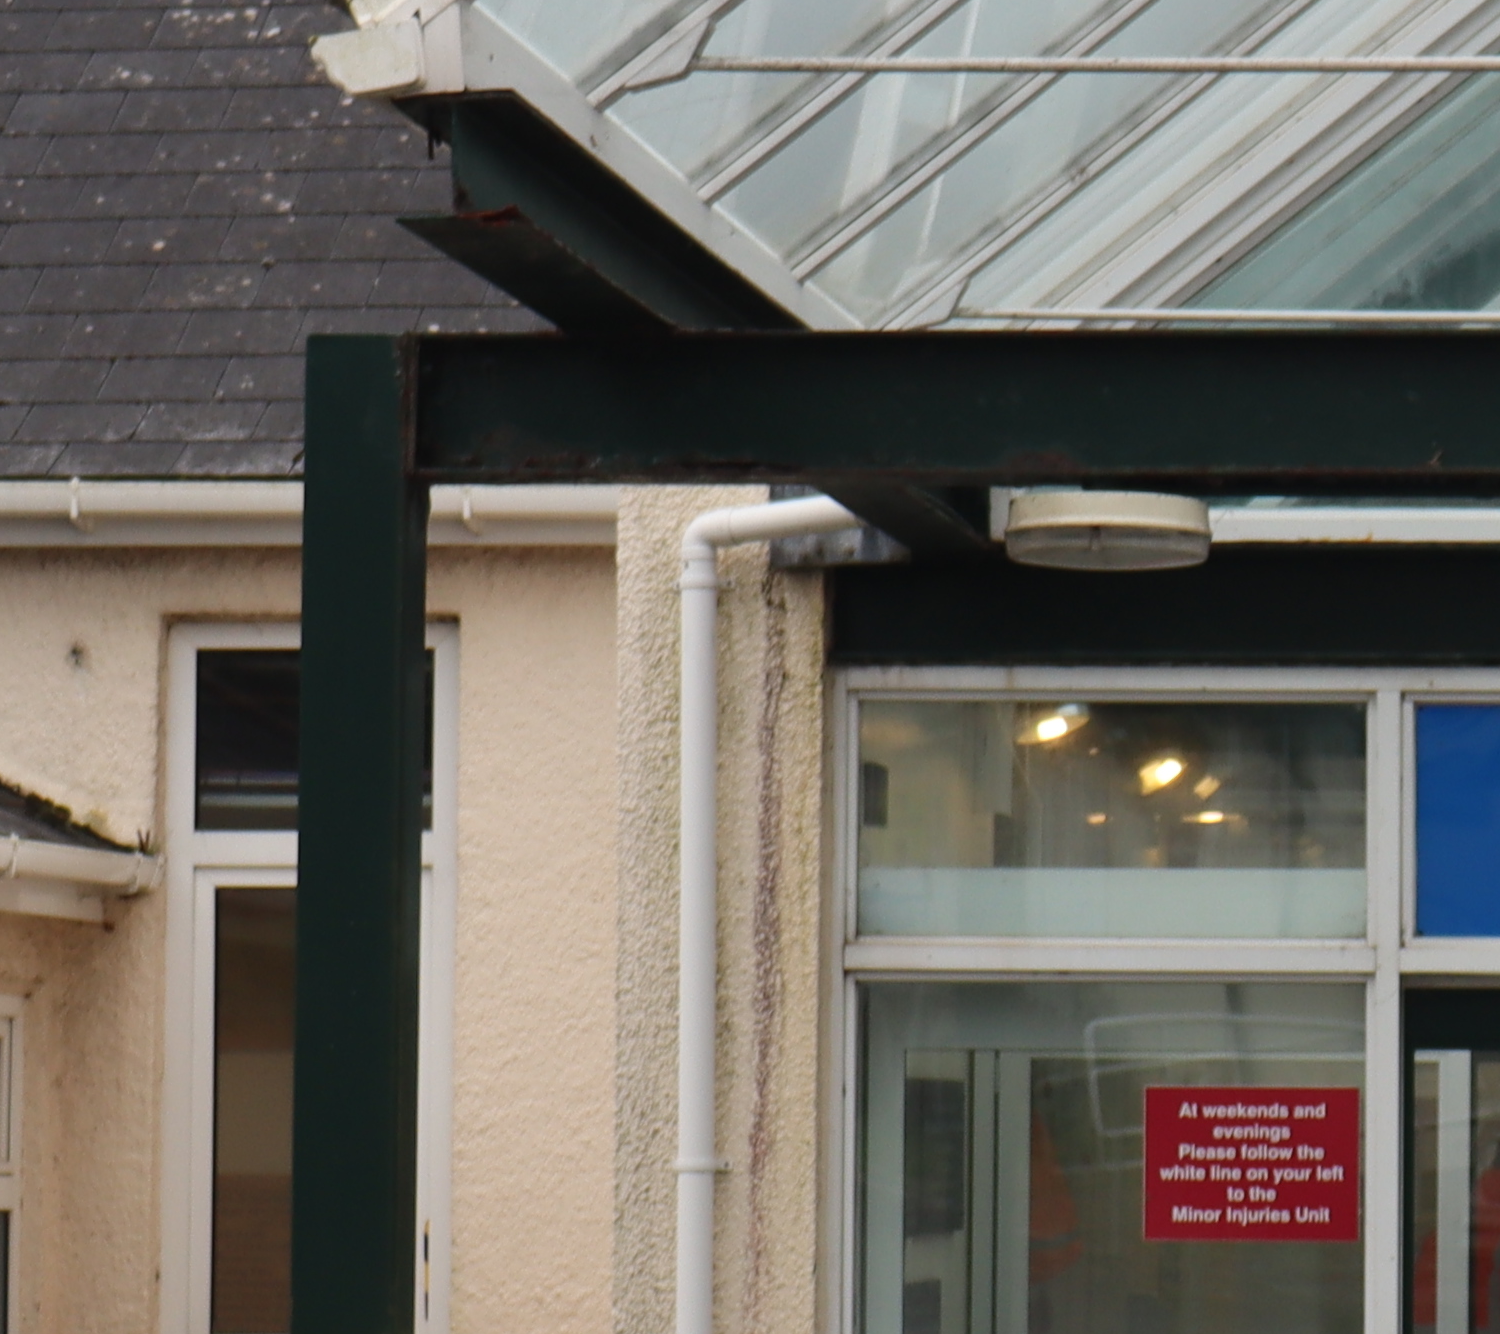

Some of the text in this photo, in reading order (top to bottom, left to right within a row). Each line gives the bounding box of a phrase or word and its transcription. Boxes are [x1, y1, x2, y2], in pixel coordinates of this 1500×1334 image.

[1179, 1102, 1326, 1119] At weekends and
[1212, 1124, 1291, 1143] evenings
[1178, 1144, 1325, 1161] Please follow the
[1160, 1165, 1345, 1185] white line on your left
[1227, 1186, 1277, 1202] to the
[1172, 1206, 1331, 1227] Minor Injuries Unit
